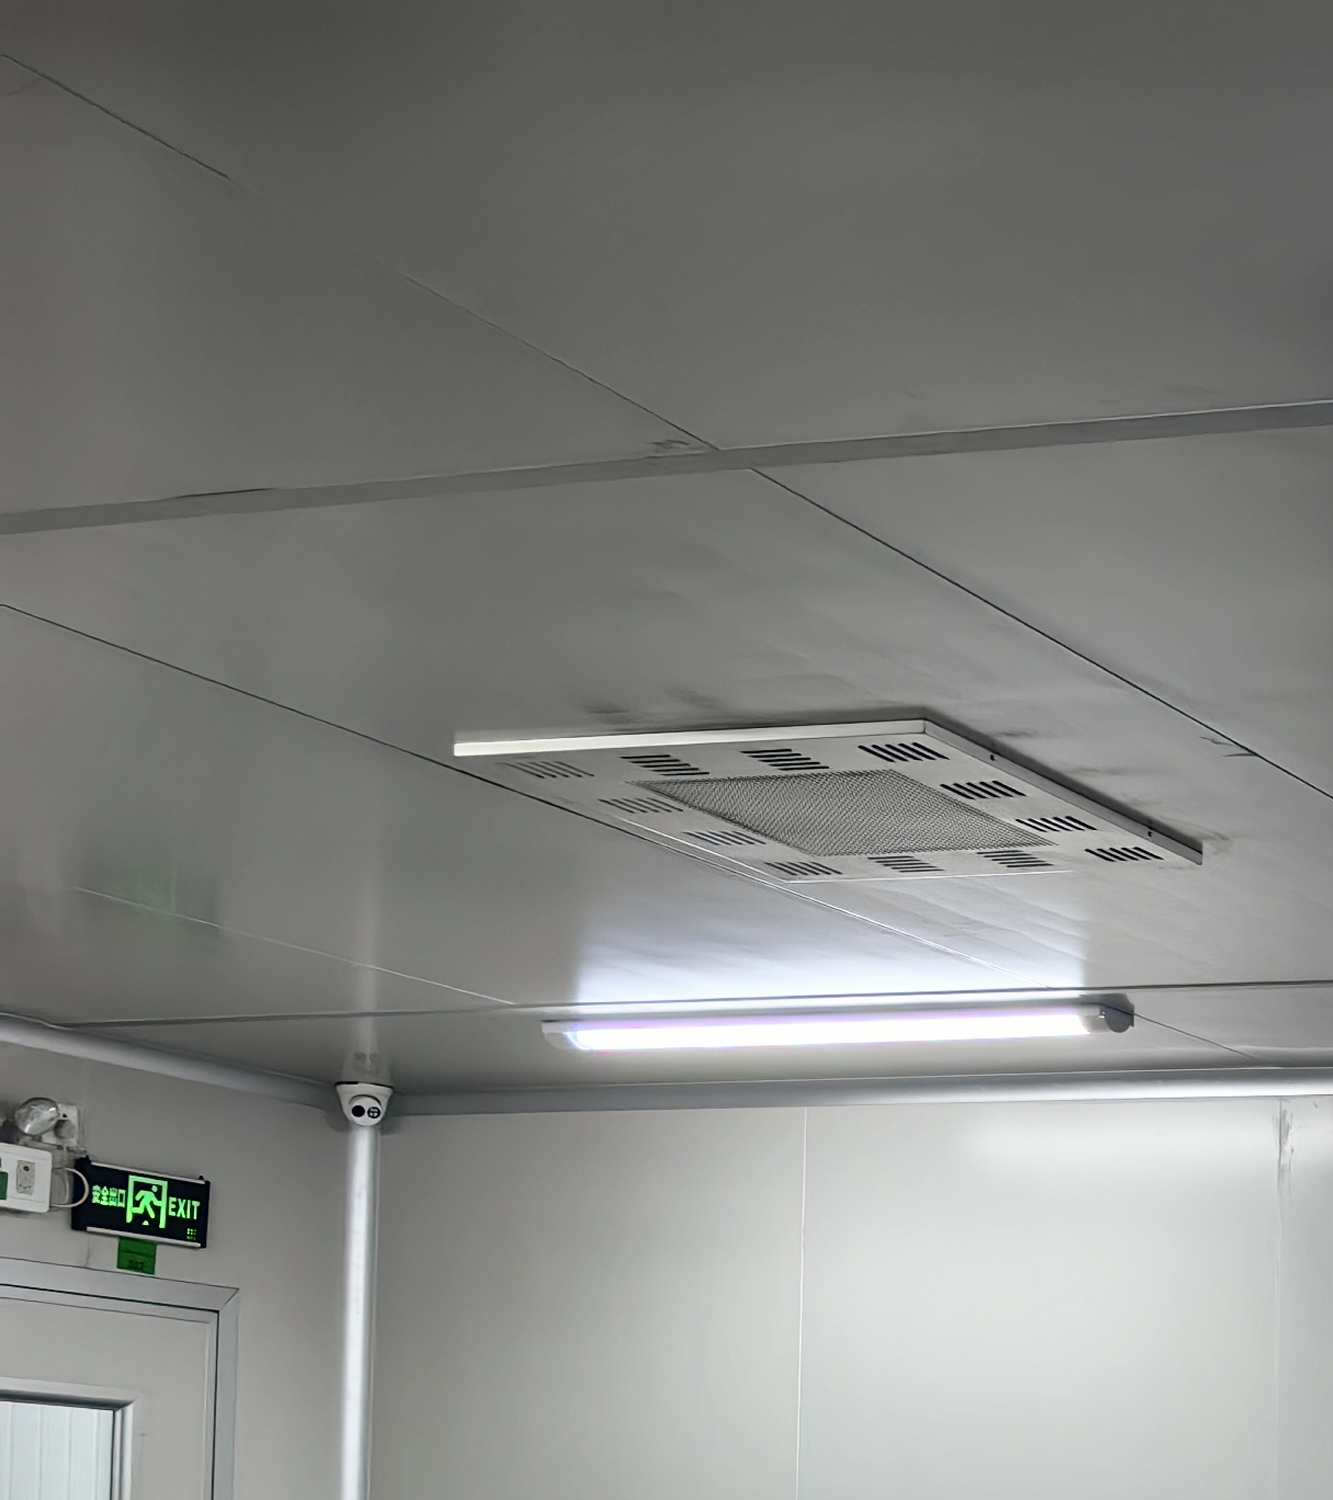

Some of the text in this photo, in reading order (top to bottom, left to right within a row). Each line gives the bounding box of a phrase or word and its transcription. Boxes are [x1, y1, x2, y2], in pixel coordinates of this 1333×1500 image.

[92, 1184, 126, 1208] 安全出口
[168, 1196, 201, 1220] EXIT
